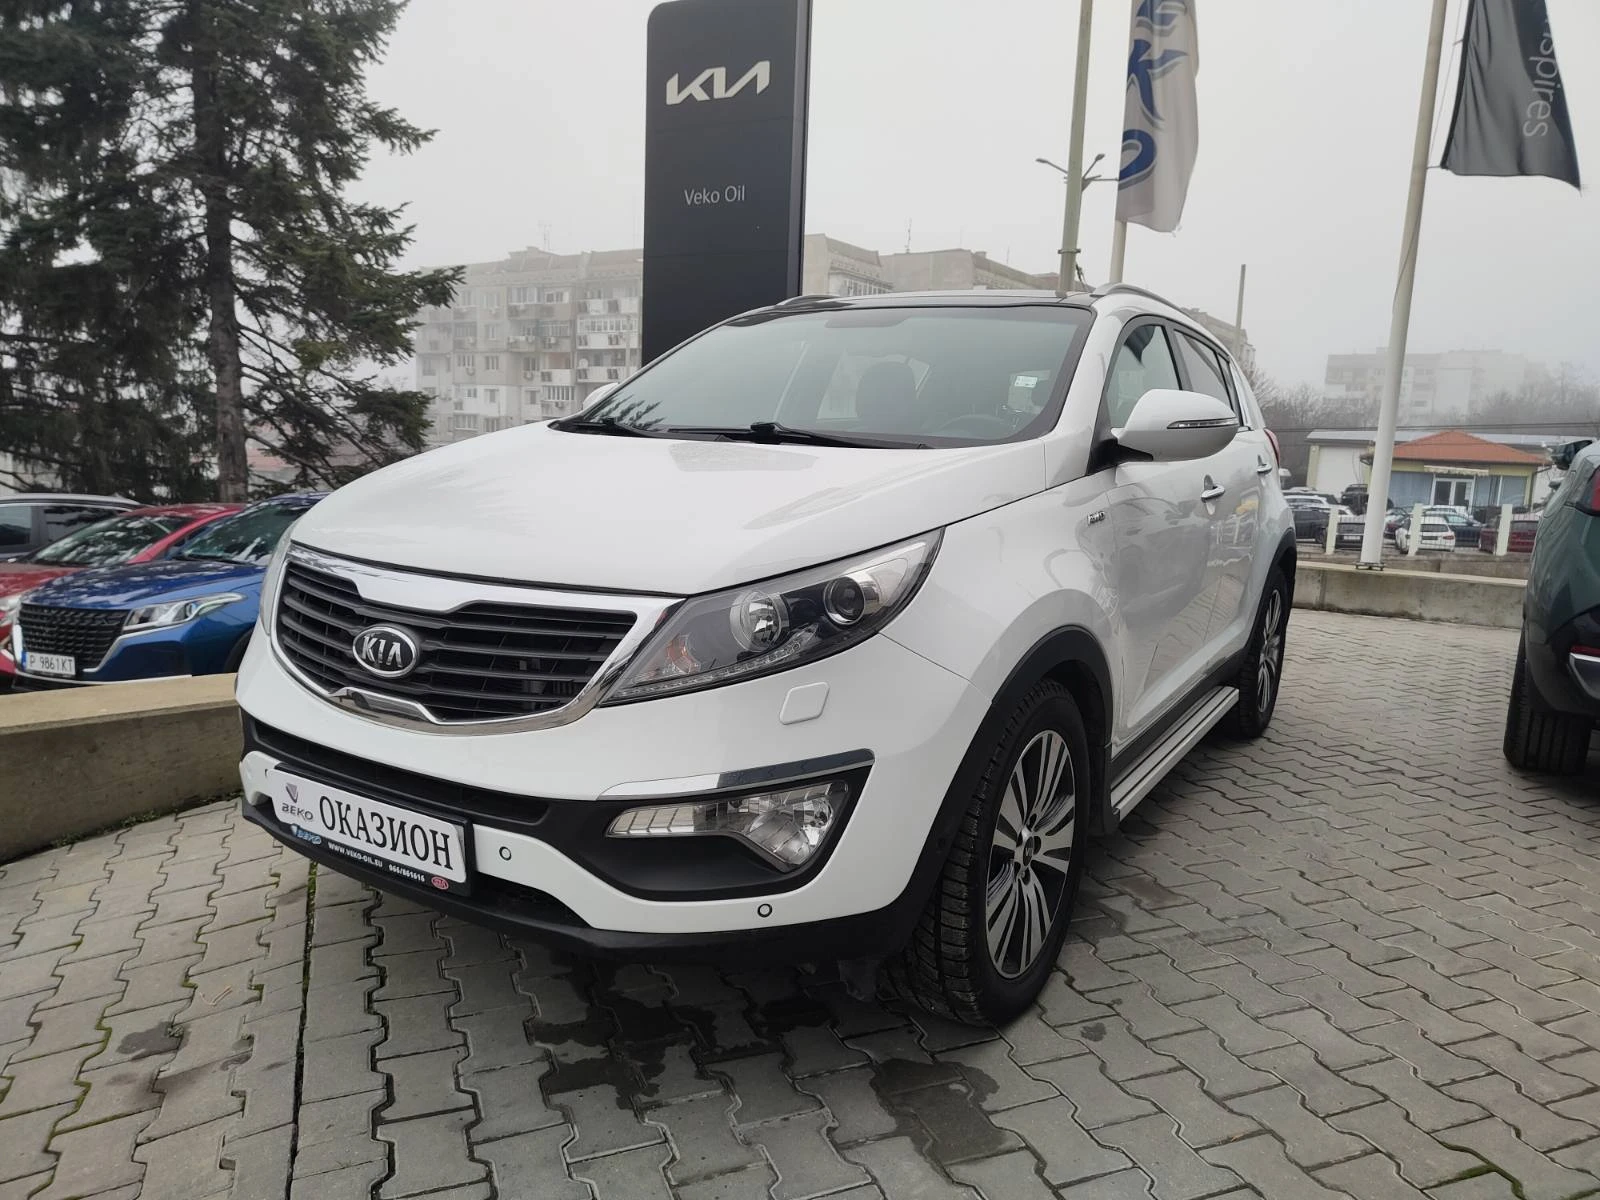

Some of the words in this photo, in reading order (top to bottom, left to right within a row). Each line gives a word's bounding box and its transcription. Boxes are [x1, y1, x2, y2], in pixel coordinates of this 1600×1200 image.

[666, 60, 770, 105] KIA
[684, 187, 720, 205] Veko
[724, 184, 745, 202] Oil
[361, 633, 403, 668] KIA
[319, 796, 454, 870] ОКАЗИОН
